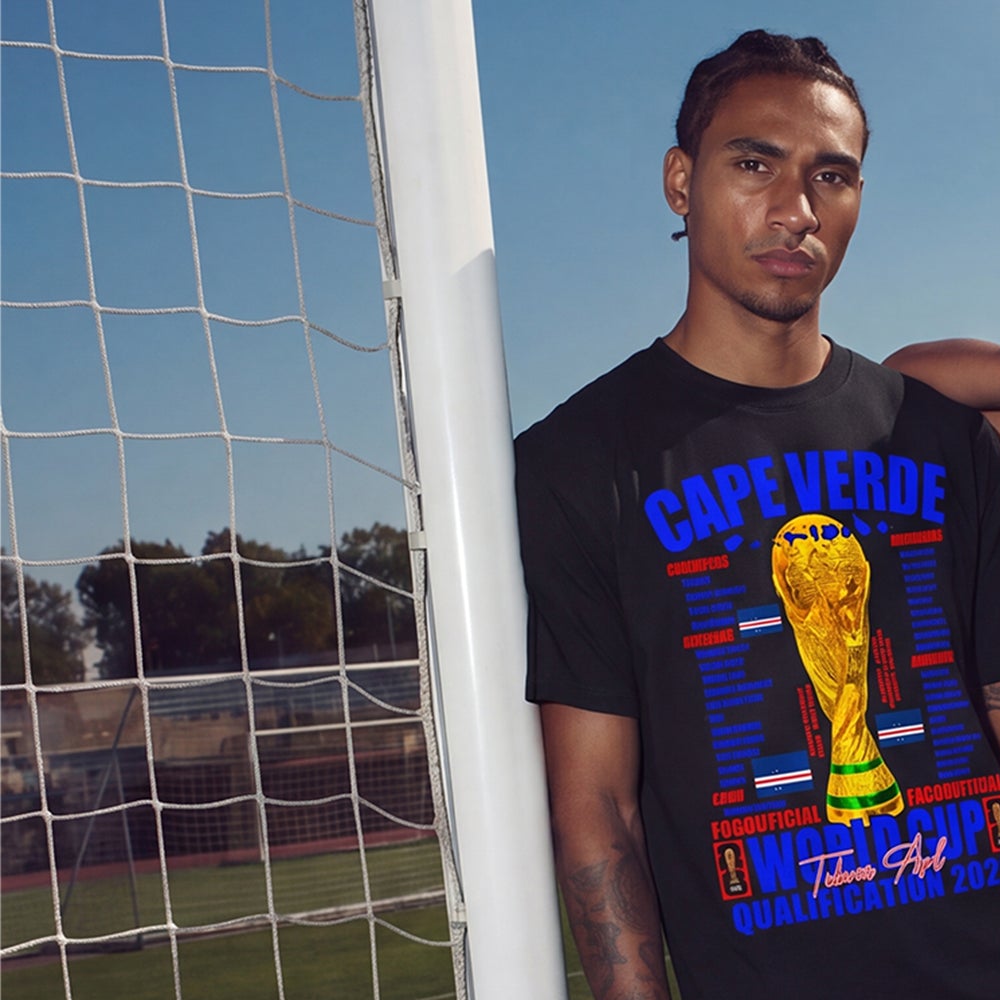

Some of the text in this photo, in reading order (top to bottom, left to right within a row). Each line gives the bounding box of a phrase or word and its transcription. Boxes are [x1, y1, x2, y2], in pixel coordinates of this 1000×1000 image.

[644, 450, 947, 553] CAPE VERDE
[906, 799, 986, 864] CUP
[732, 868, 946, 936] QUALIFICATION
